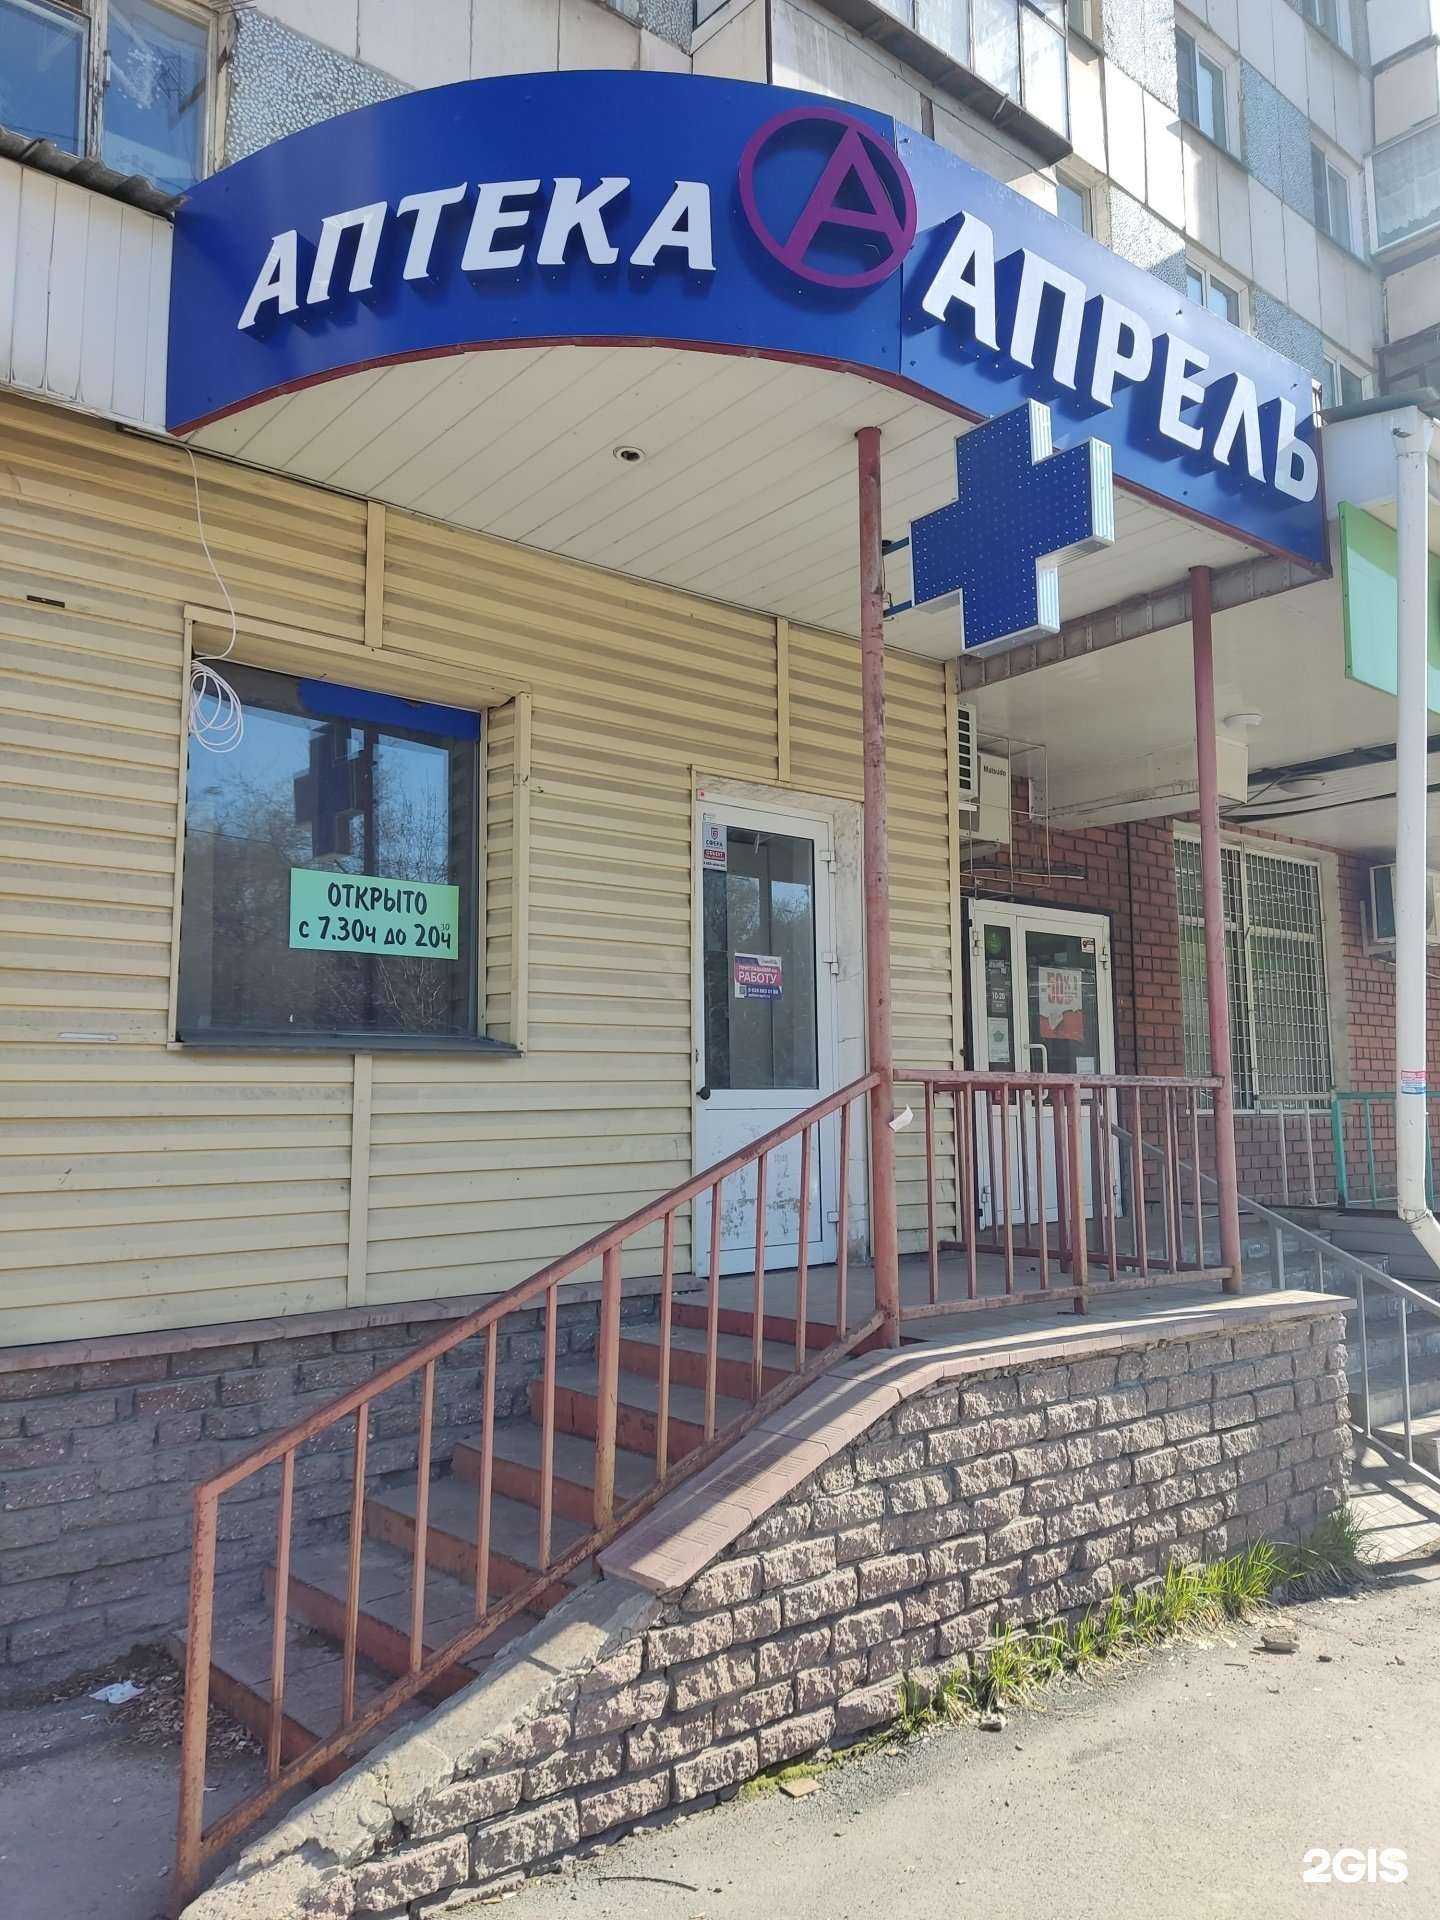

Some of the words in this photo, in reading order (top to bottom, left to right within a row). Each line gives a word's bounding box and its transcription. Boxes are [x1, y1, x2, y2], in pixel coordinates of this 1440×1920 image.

[238, 177, 716, 329] АПТЕКА
[922, 210, 1317, 503] АПРЕЛЬ
[327, 882, 428, 915] ОТКРЫТО
[318, 915, 377, 944] 7.30ч
[384, 927, 407, 946] до
[738, 970, 777, 985] РАБОТУ
